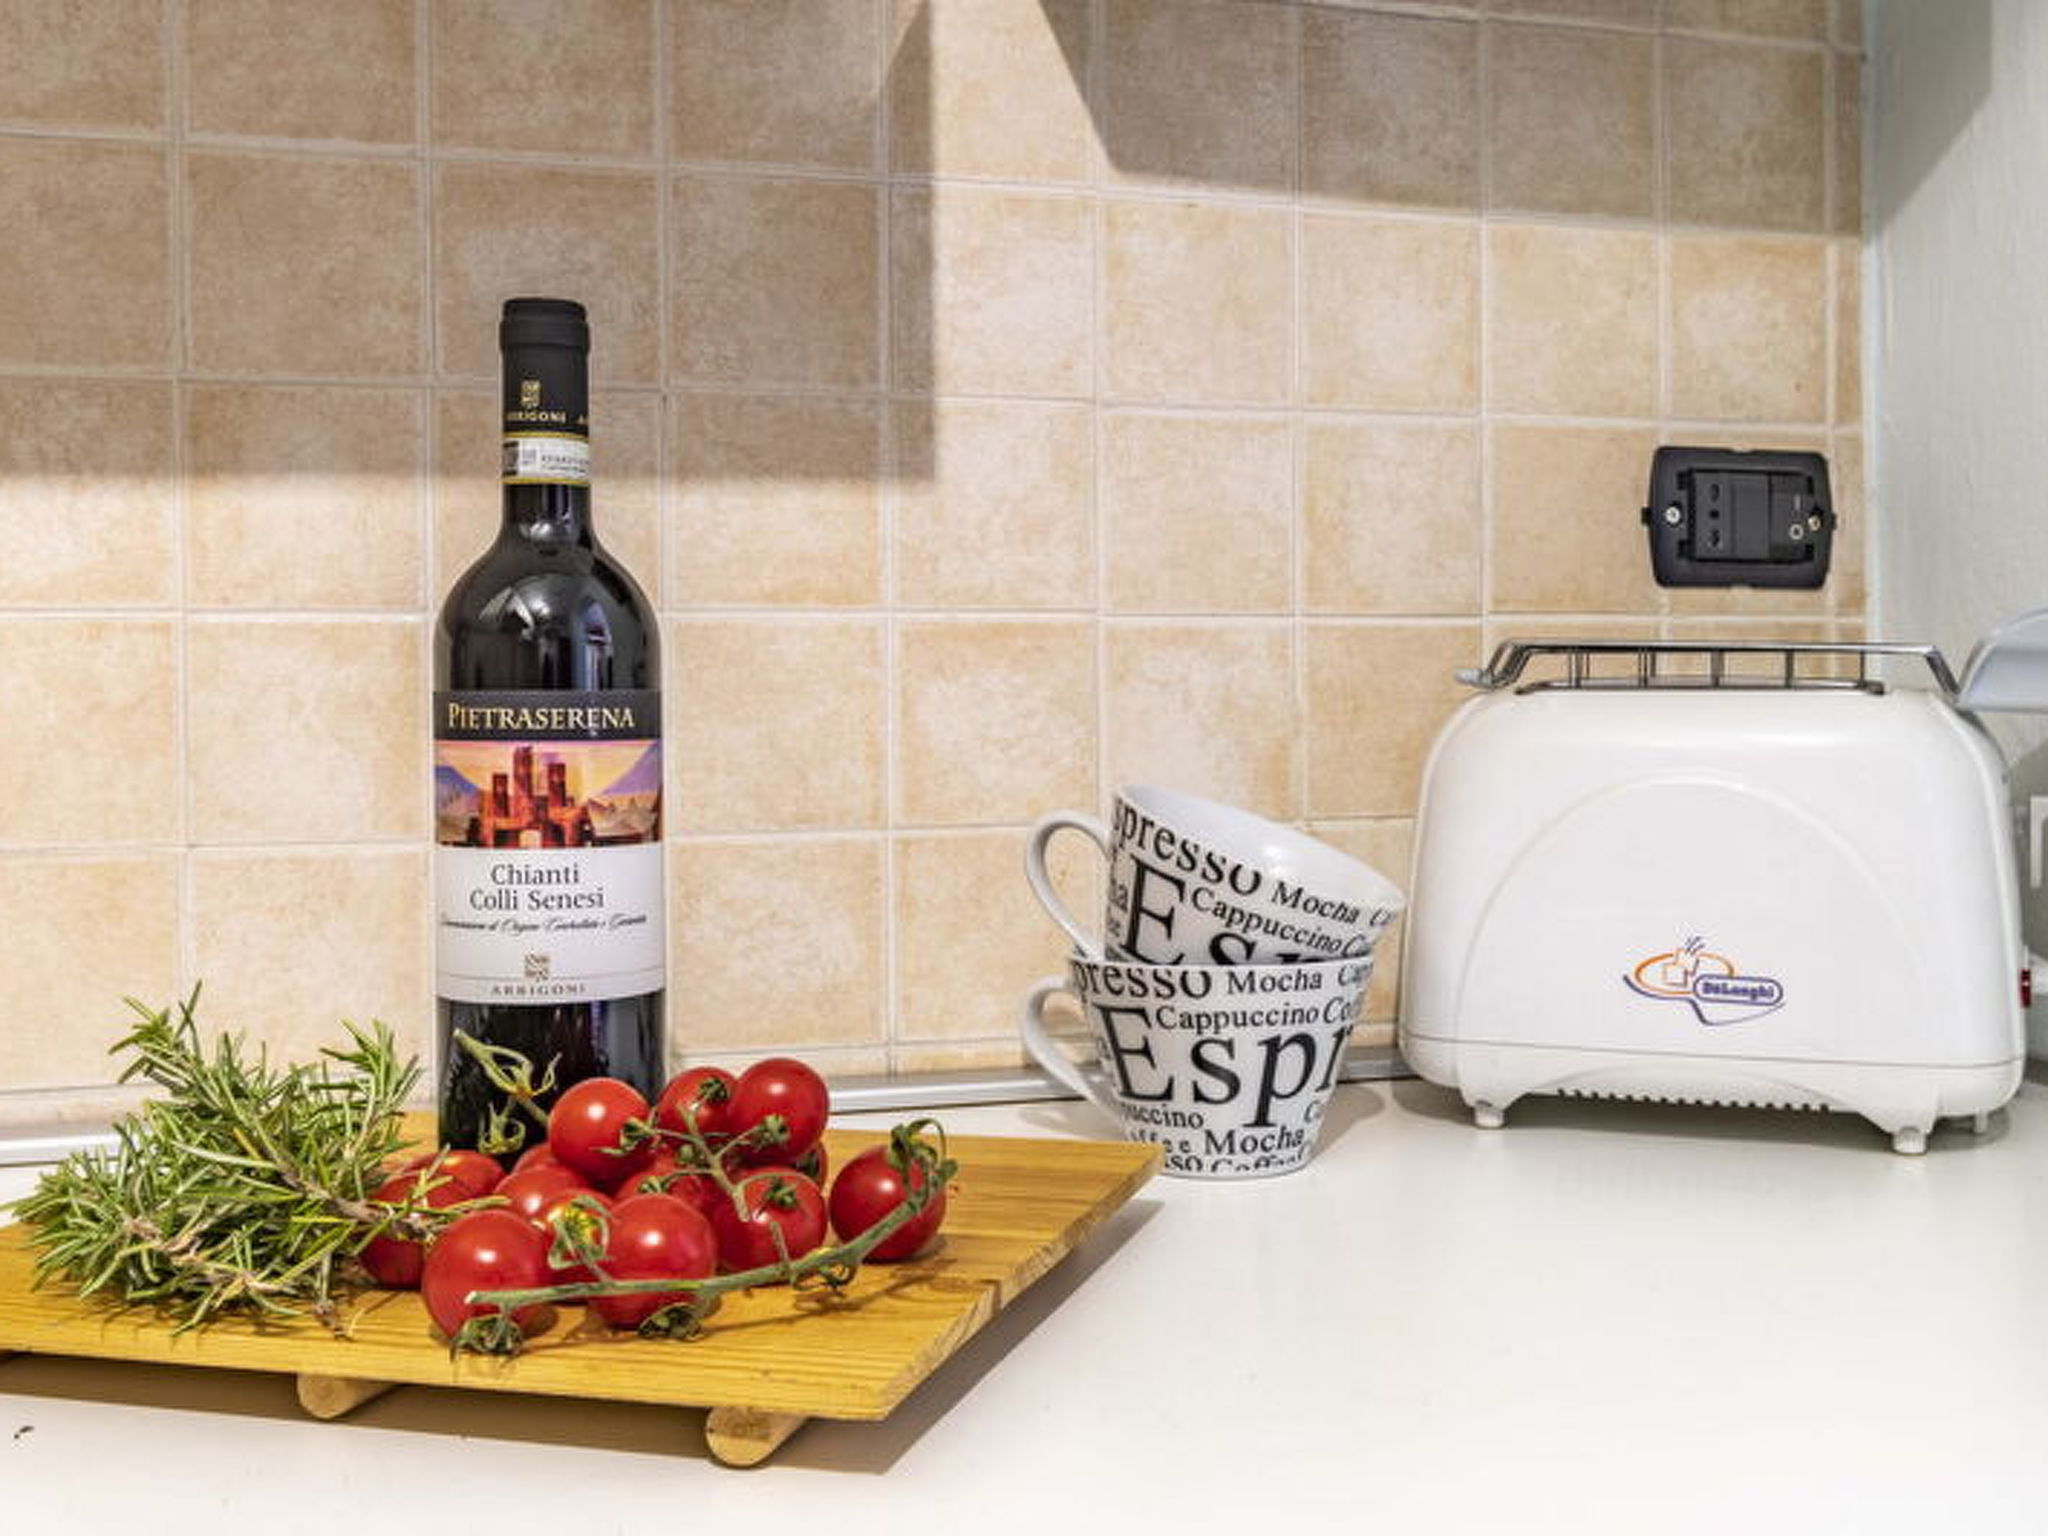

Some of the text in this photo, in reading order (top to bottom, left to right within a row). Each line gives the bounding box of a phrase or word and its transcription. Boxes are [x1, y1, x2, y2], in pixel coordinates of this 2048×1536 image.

[449, 703, 635, 731] PIETRASERENA
[490, 864, 580, 886] Chianti
[470, 887, 605, 911] Colli Senesi
[1272, 880, 1360, 925] Mocha
[1191, 887, 1343, 953] Cappuccino
[1227, 968, 1323, 995] Mocha
[1155, 1003, 1319, 1035] Cappuccino
[1204, 1126, 1304, 1156] Mocha
